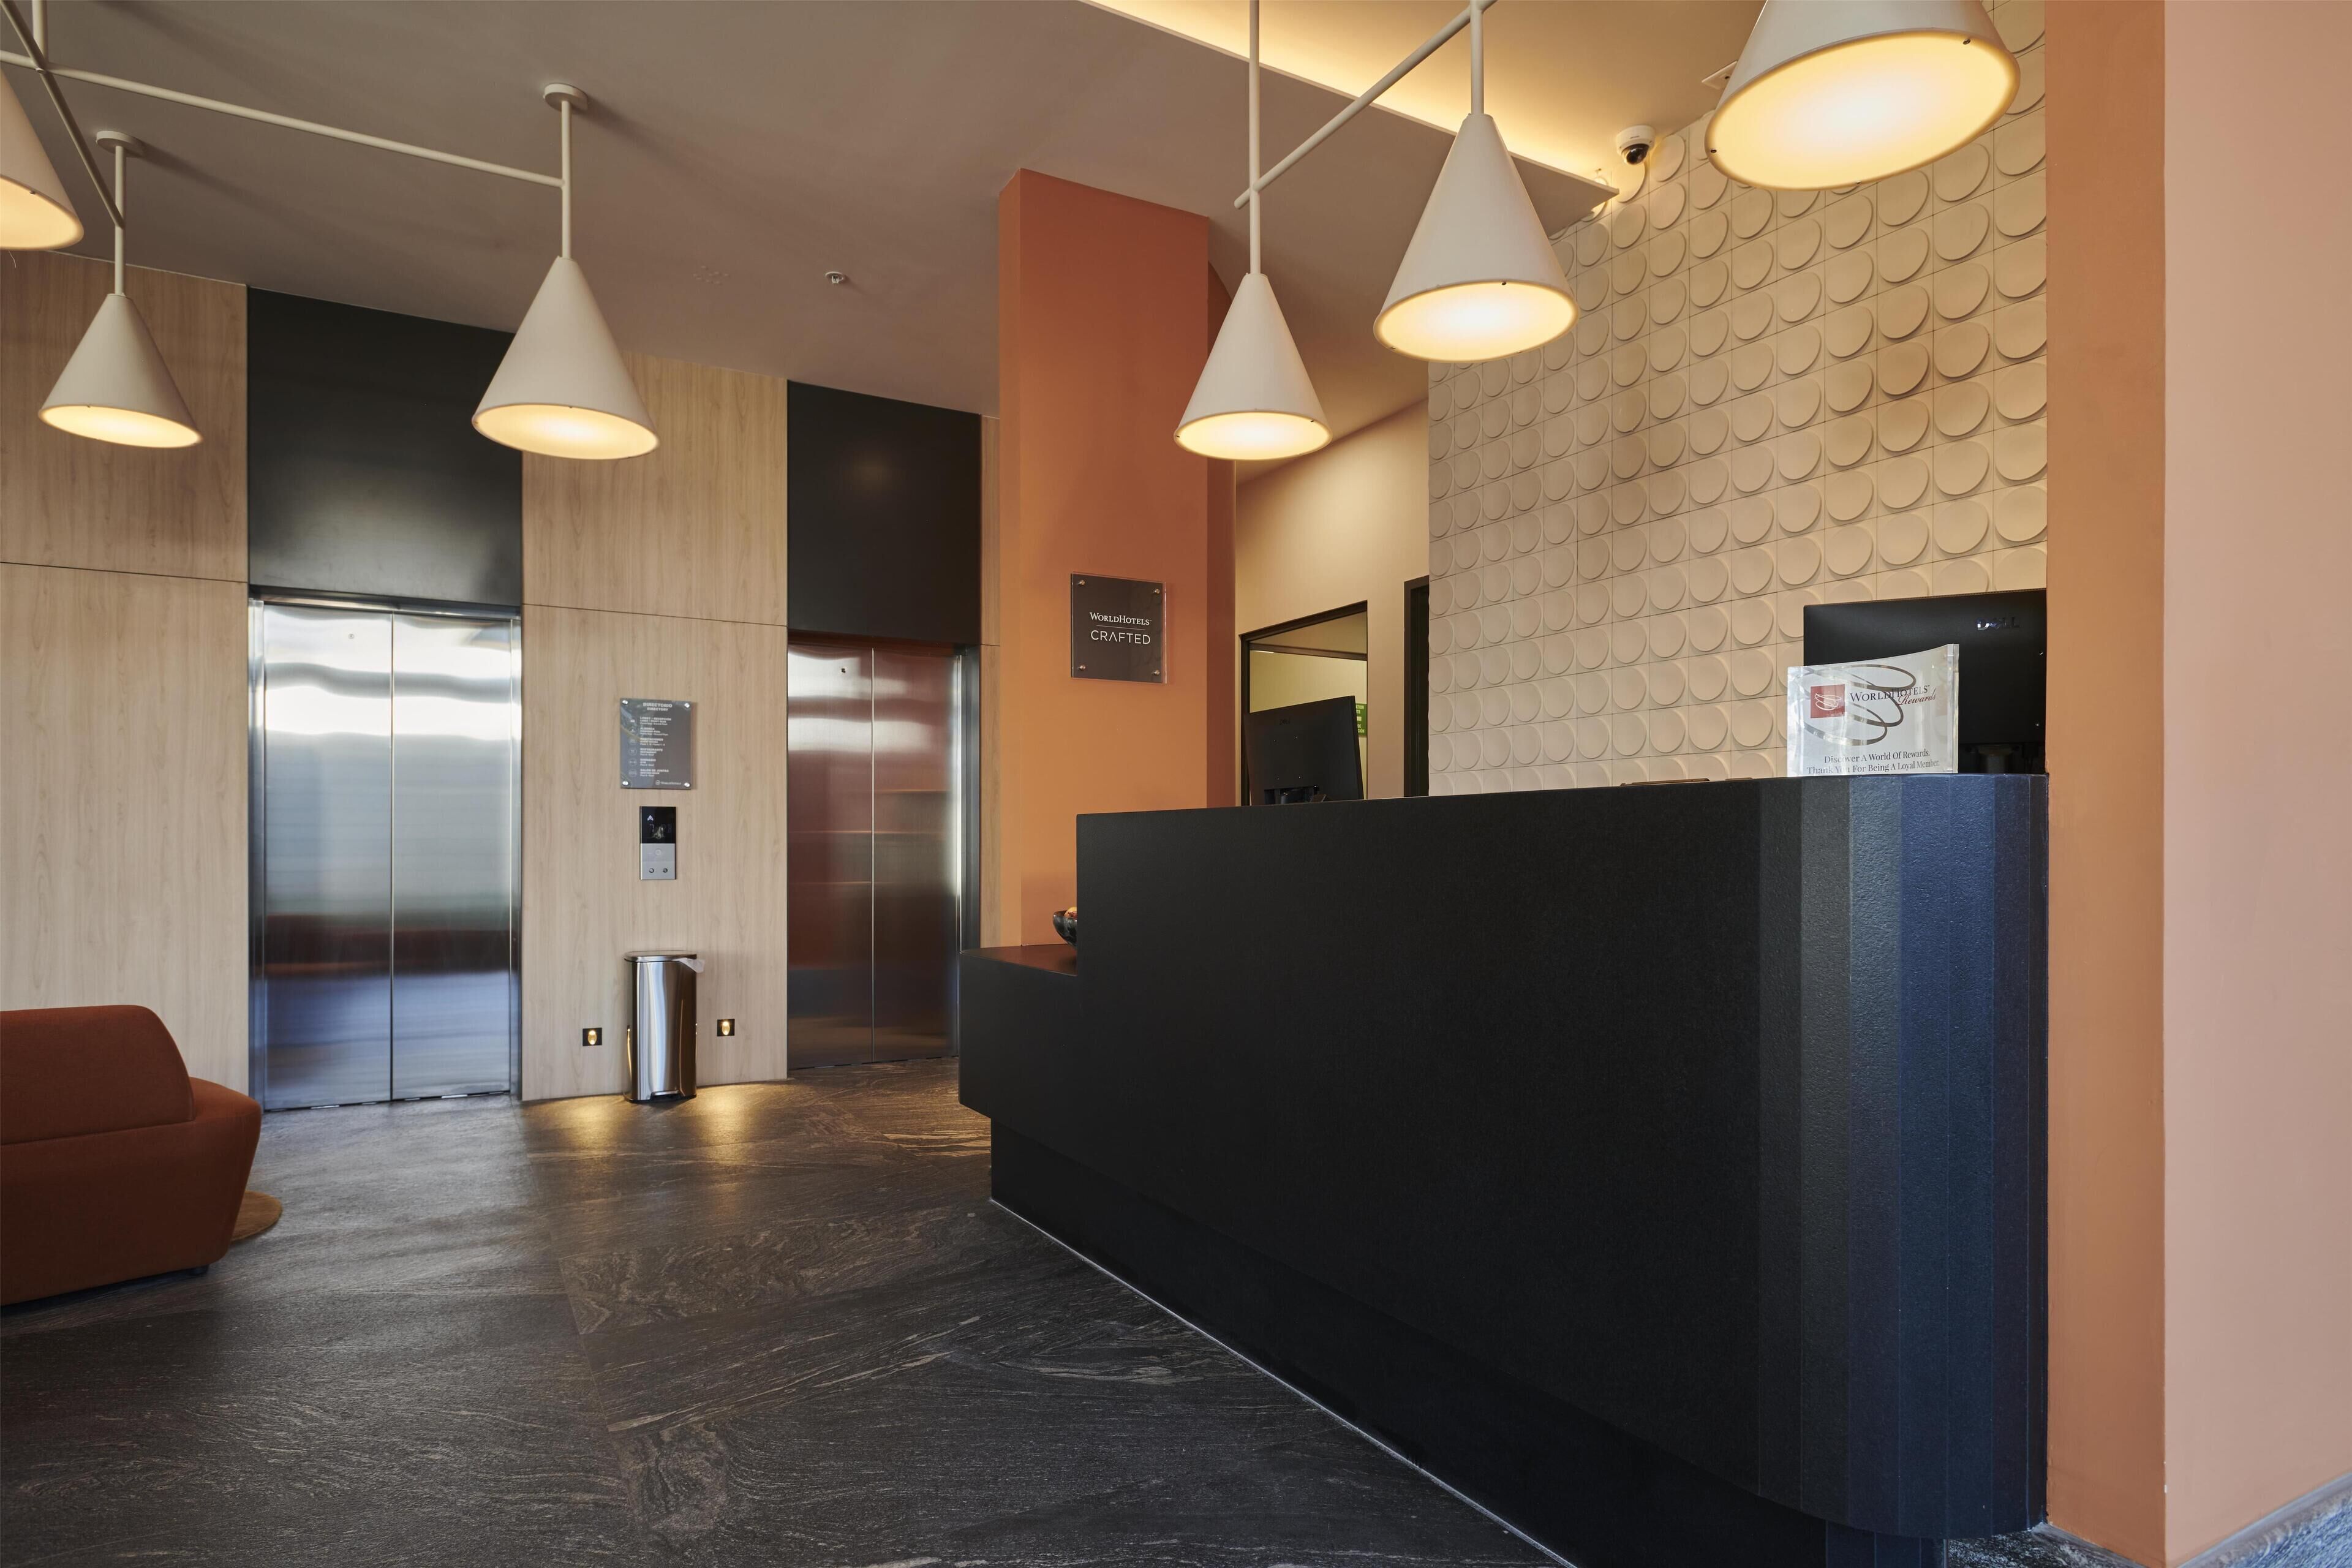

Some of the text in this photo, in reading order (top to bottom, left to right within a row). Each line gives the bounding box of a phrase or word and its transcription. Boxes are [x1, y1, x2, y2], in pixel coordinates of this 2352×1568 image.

[1090, 630, 1151, 644] CRAFTED
[1896, 688, 1937, 706] Rewards
[1868, 752, 1891, 761] World
[1892, 751, 1902, 760] Of
[1903, 748, 1931, 758] Rewards.
[1868, 764, 1890, 772] Being
[1898, 761, 1915, 771] Loyal
[1917, 760, 1940, 769] Member.
